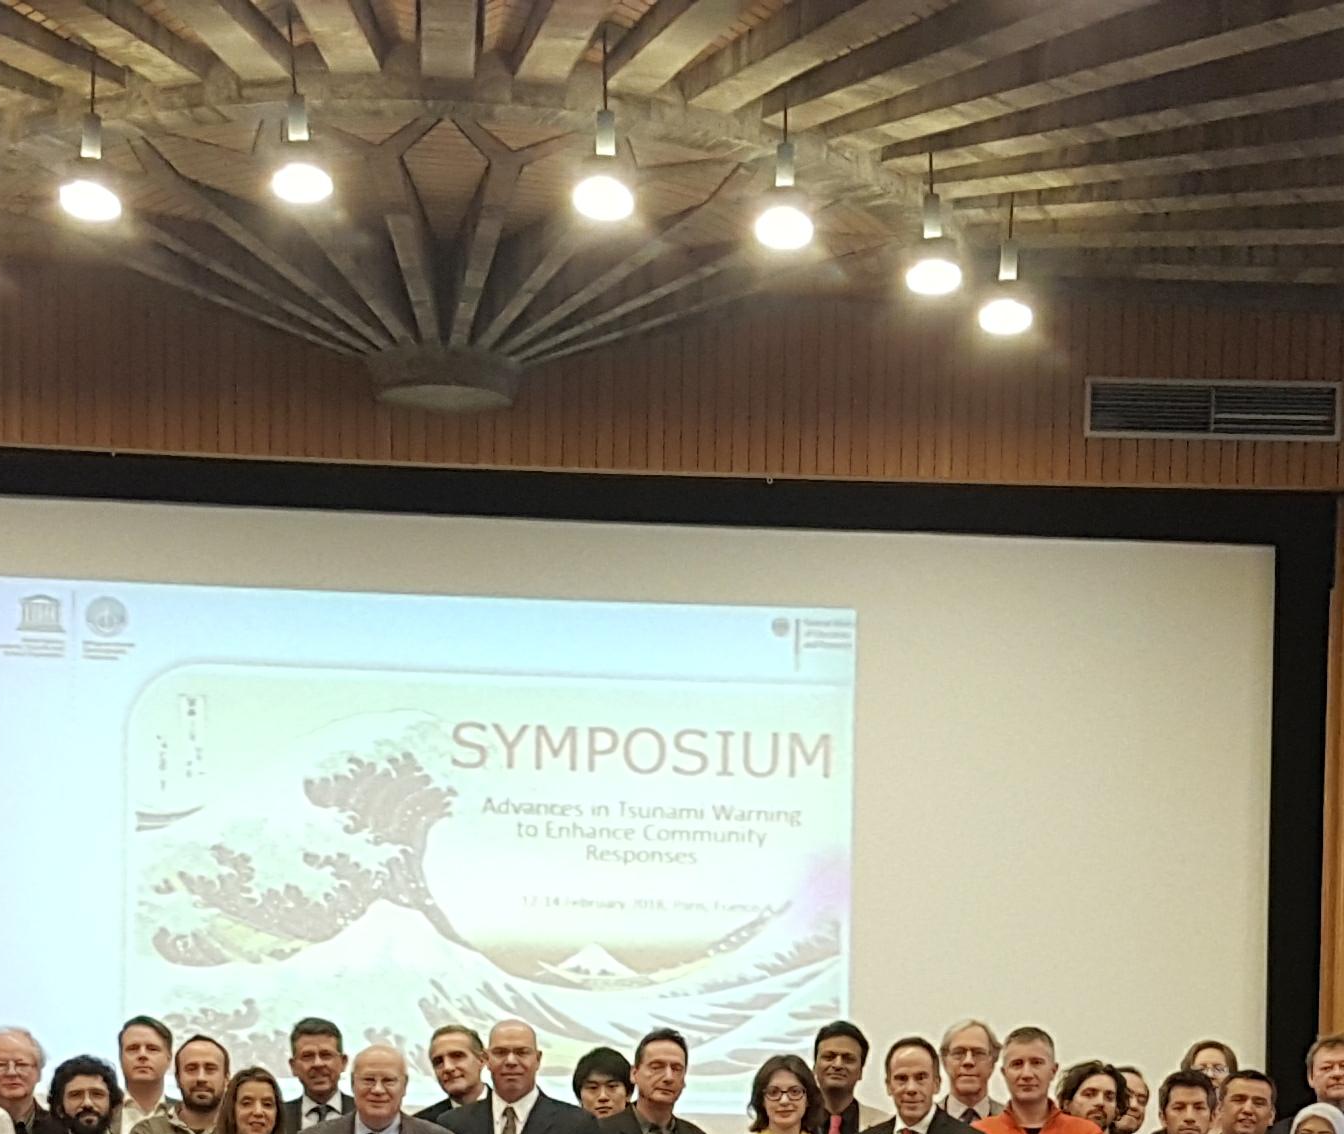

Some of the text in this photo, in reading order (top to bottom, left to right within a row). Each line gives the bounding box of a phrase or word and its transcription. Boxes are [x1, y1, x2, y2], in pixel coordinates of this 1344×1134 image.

[451, 721, 832, 779] SYMPOSIUM
[482, 797, 802, 827] Advances in Tsunami Warning
[517, 821, 767, 847] to Enhance Community
[586, 845, 697, 865] Responses
